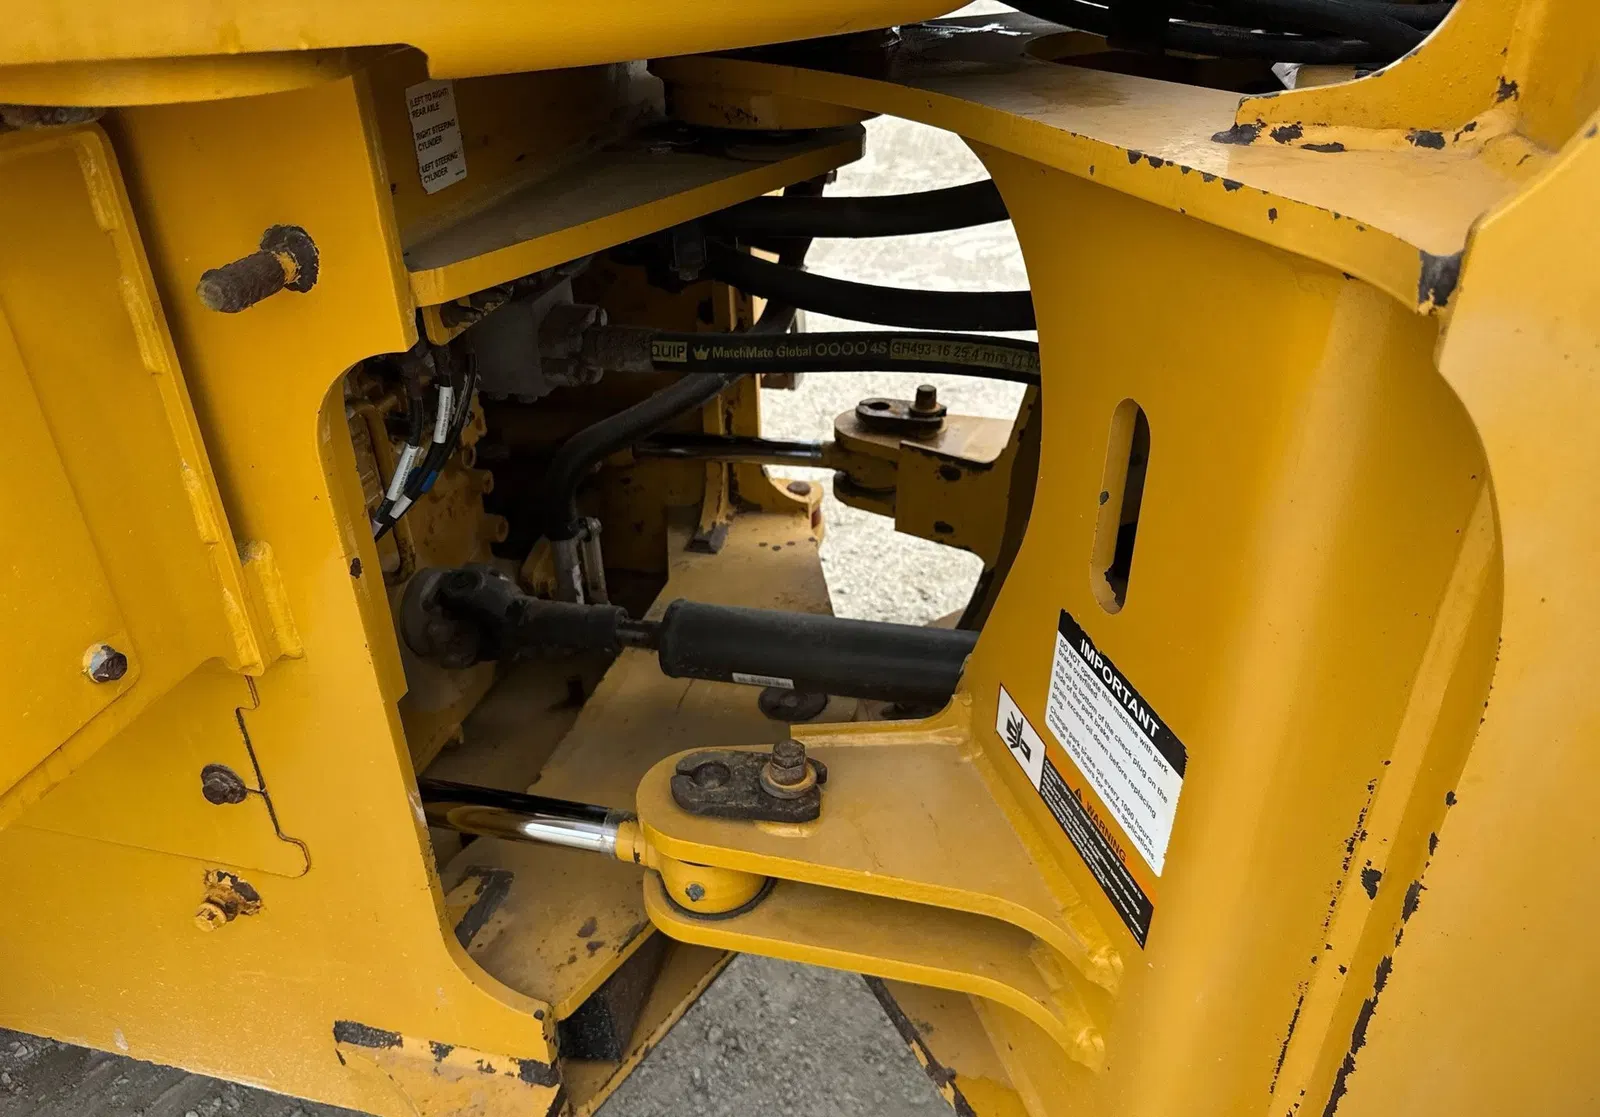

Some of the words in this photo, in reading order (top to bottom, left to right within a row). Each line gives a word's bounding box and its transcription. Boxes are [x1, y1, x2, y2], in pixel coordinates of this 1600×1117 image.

[412, 107, 426, 118] REAR
[427, 102, 439, 112] AXLE
[424, 93, 431, 101] TO
[416, 128, 431, 140] RIGHT
[432, 119, 455, 133] STEERING
[418, 135, 442, 151] CYLINDER
[422, 161, 434, 173] LEFT
[435, 151, 458, 167] STEERING
[424, 167, 448, 183] CYLINDER
[712, 346, 774, 359] MatchMate
[776, 345, 812, 358] Global
[892, 341, 950, 356] GH493-16
[954, 345, 979, 358] 25.4
[982, 351, 1008, 364] mm
[1052, 690, 1064, 711] plug.
[1058, 647, 1071, 668] brake
[1073, 665, 1098, 701] overfilled.
[1080, 638, 1159, 740] IMPORTANT
[1055, 669, 1065, 686] side
[1066, 683, 1072, 694] of
[1072, 691, 1080, 705] the
[1081, 702, 1093, 722] park
[1094, 718, 1110, 743] brake.
[1056, 660, 1064, 674] Fill
[1072, 680, 1077, 691] to
[1078, 687, 1096, 714] bottom
[1097, 711, 1104, 724] of
[1105, 720, 1113, 736] the
[1114, 732, 1131, 758] check
[1132, 755, 1146, 778] plug
[1147, 775, 1156, 789] on
[1156, 785, 1167, 804] the
[1059, 638, 1068, 654] DO
[1068, 649, 1080, 668] NOT
[1080, 665, 1100, 694] operate
[1101, 690, 1112, 708] this
[1113, 704, 1138, 739] machine
[1139, 735, 1152, 756] with
[1153, 753, 1168, 776] park
[1050, 704, 1068, 733] Change
[1068, 730, 1079, 749] park
[1080, 745, 1095, 769] brake
[1103, 777, 1119, 802] every
[1120, 798, 1134, 821] 1000
[1134, 817, 1154, 848] hours.
[1053, 681, 1066, 702] Drain
[1067, 699, 1084, 725] excess
[1093, 731, 1108, 755] down
[1109, 752, 1127, 780] before
[1127, 777, 1156, 819] replacing
[1049, 713, 1065, 741] Change
[1066, 737, 1070, 747] at
[1080, 755, 1094, 779] hours
[1103, 788, 1120, 814] severe
[1120, 810, 1156, 863] applications.
[1086, 800, 1126, 864] WARNING
